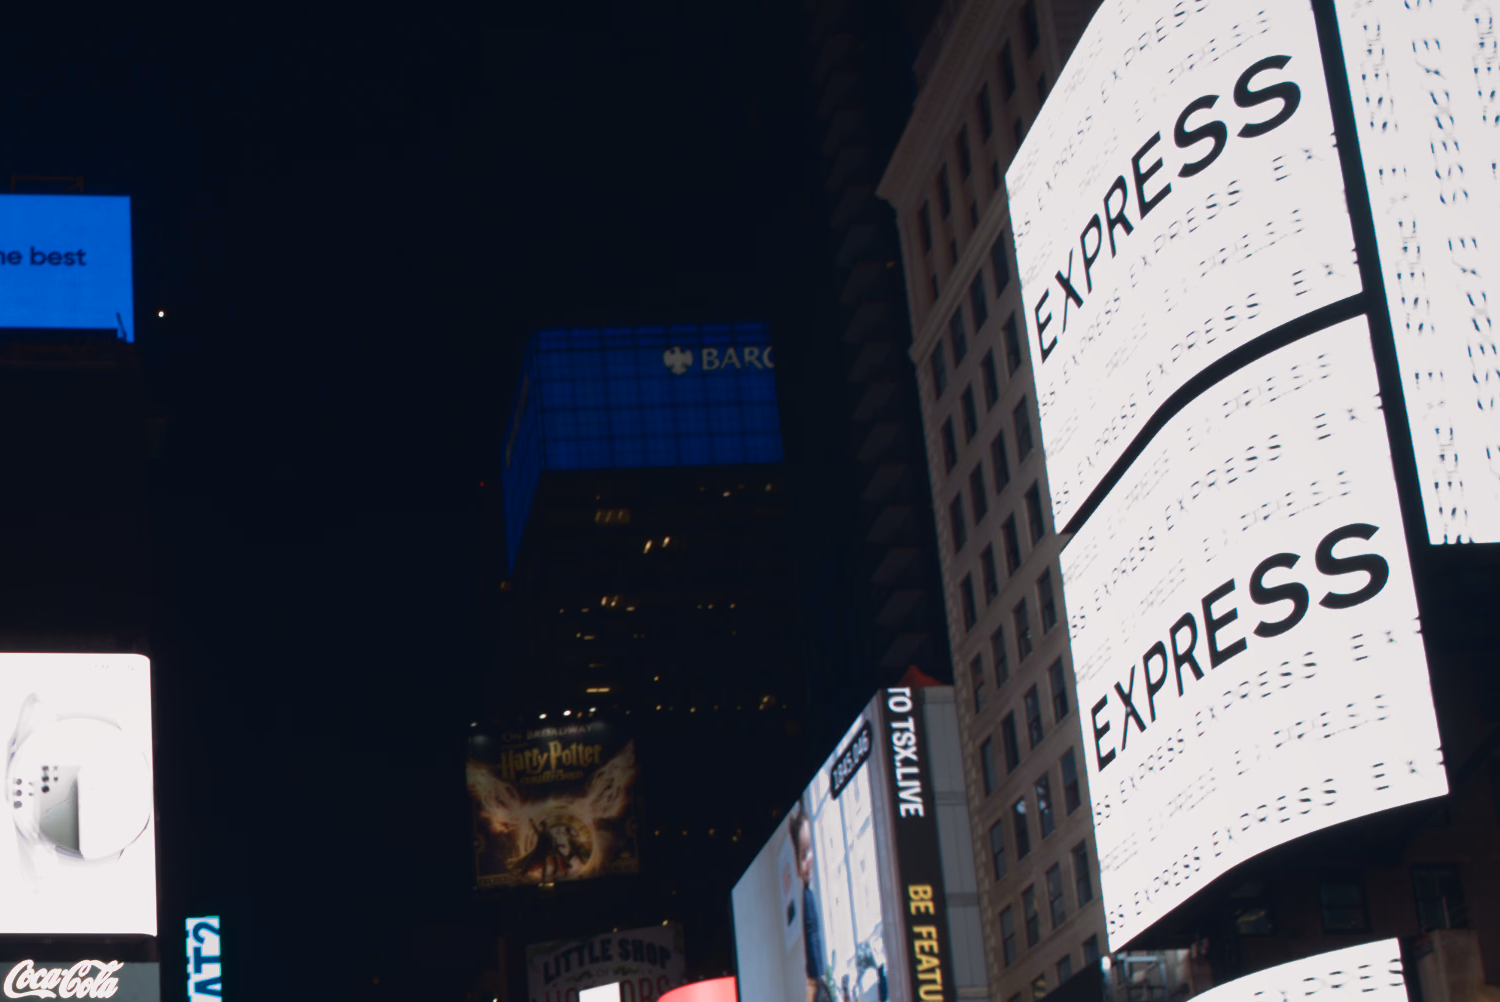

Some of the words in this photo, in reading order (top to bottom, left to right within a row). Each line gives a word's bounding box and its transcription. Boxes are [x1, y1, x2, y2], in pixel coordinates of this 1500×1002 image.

[1034, 54, 1302, 364] EXPRESS
[29, 246, 87, 267] best
[1091, 523, 1390, 773] EXPRESS
[886, 686, 914, 714] TO
[500, 745, 549, 781] Harry
[547, 740, 604, 770] Potter
[889, 716, 925, 819] TSX.LIVE
[907, 883, 936, 916] BE
[543, 937, 614, 985] LITTLE
[618, 938, 672, 970] SHOP
